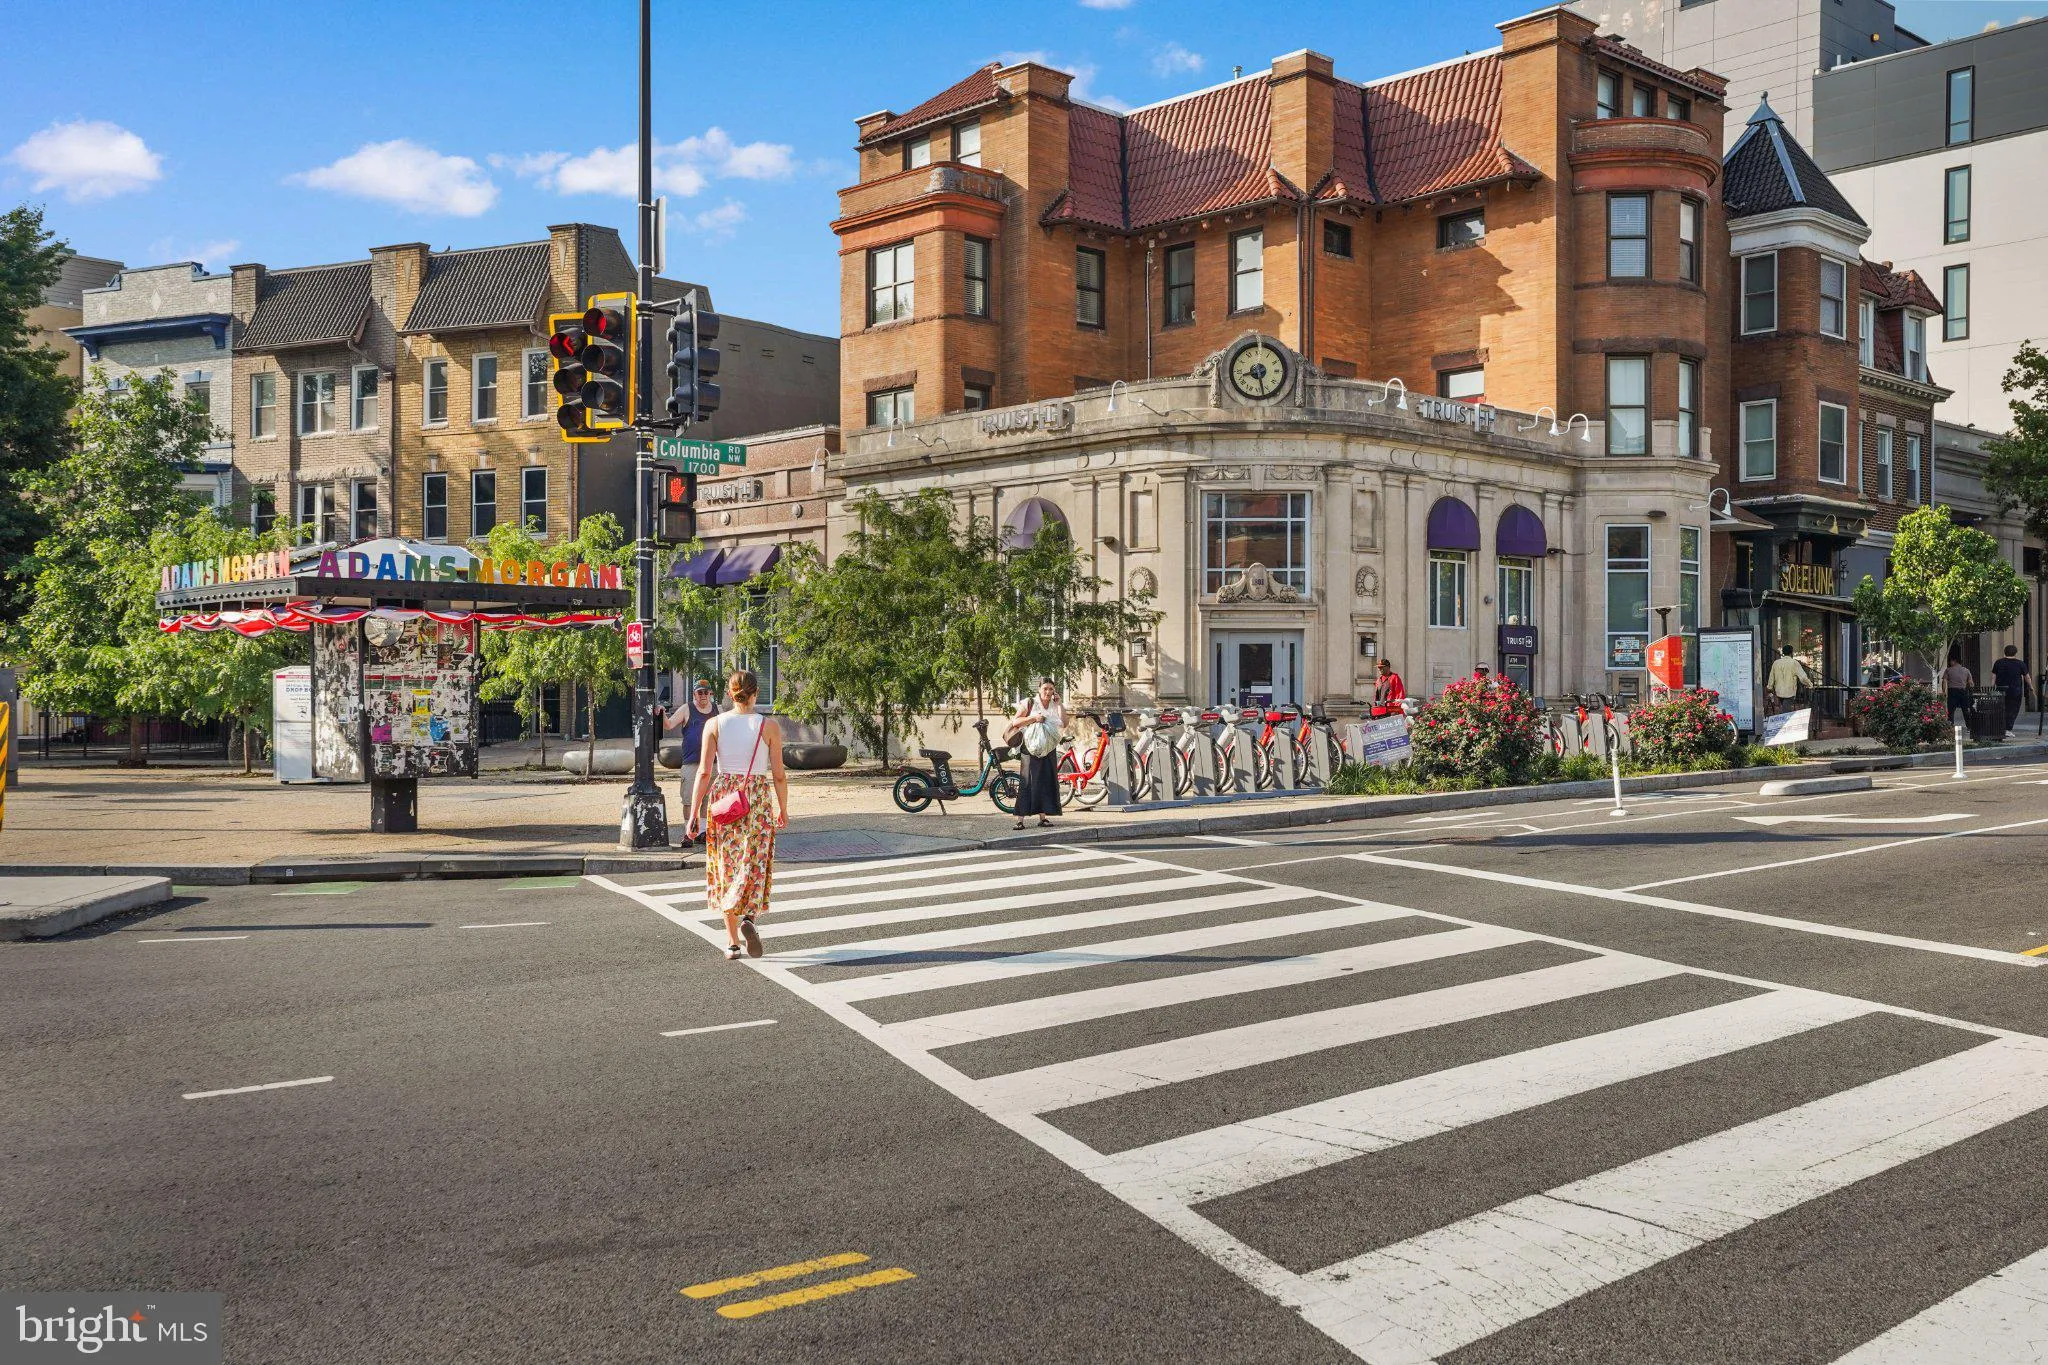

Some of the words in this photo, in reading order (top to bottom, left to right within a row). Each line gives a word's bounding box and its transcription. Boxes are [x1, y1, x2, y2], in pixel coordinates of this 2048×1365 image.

[975, 407, 1034, 433] TRUIST
[1420, 399, 1474, 426] TRUIST
[660, 440, 720, 460] Columbia
[728, 445, 740, 454] RD
[728, 454, 740, 463] NW
[688, 461, 716, 474] 1700
[161, 558, 215, 592] ADAMS
[218, 550, 290, 584] MORGAN
[317, 550, 458, 582] ADAMS
[468, 557, 618, 589] MORGAN
[1506, 636, 1525, 645] TRUIST
[938, 764, 948, 784] veo
